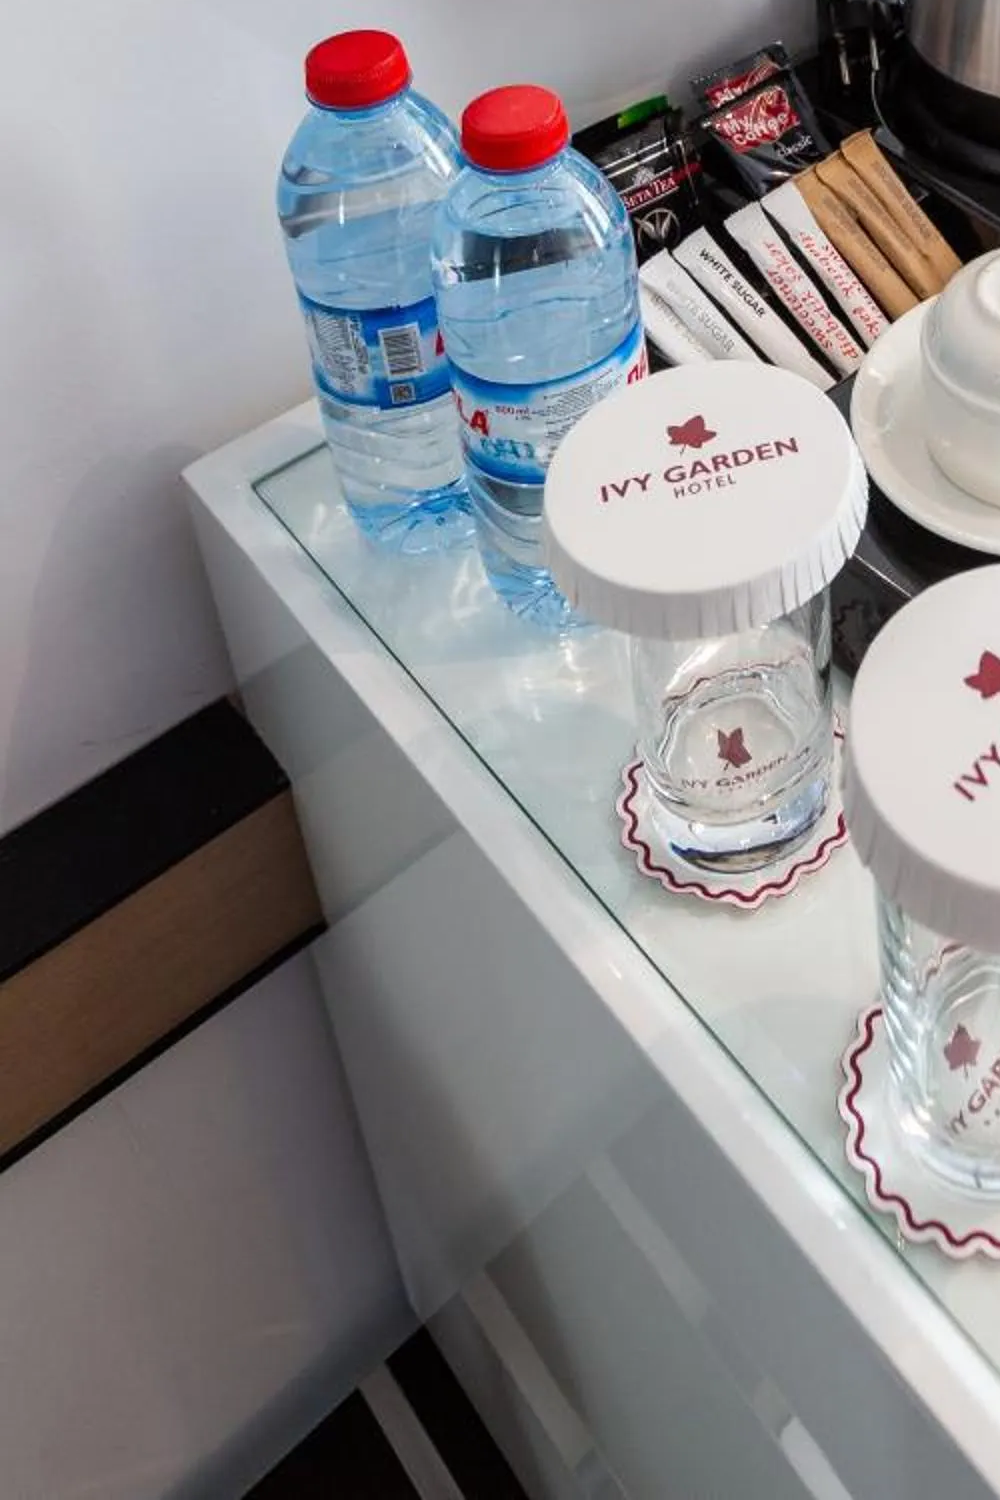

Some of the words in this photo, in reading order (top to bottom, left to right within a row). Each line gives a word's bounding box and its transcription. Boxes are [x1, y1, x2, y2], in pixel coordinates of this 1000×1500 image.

[724, 114, 750, 137] My
[699, 247, 735, 283] WHITE
[732, 279, 766, 318] SUGAR
[600, 473, 652, 503] IVY
[663, 437, 800, 483] GARDEN
[673, 472, 737, 499] HOTEL
